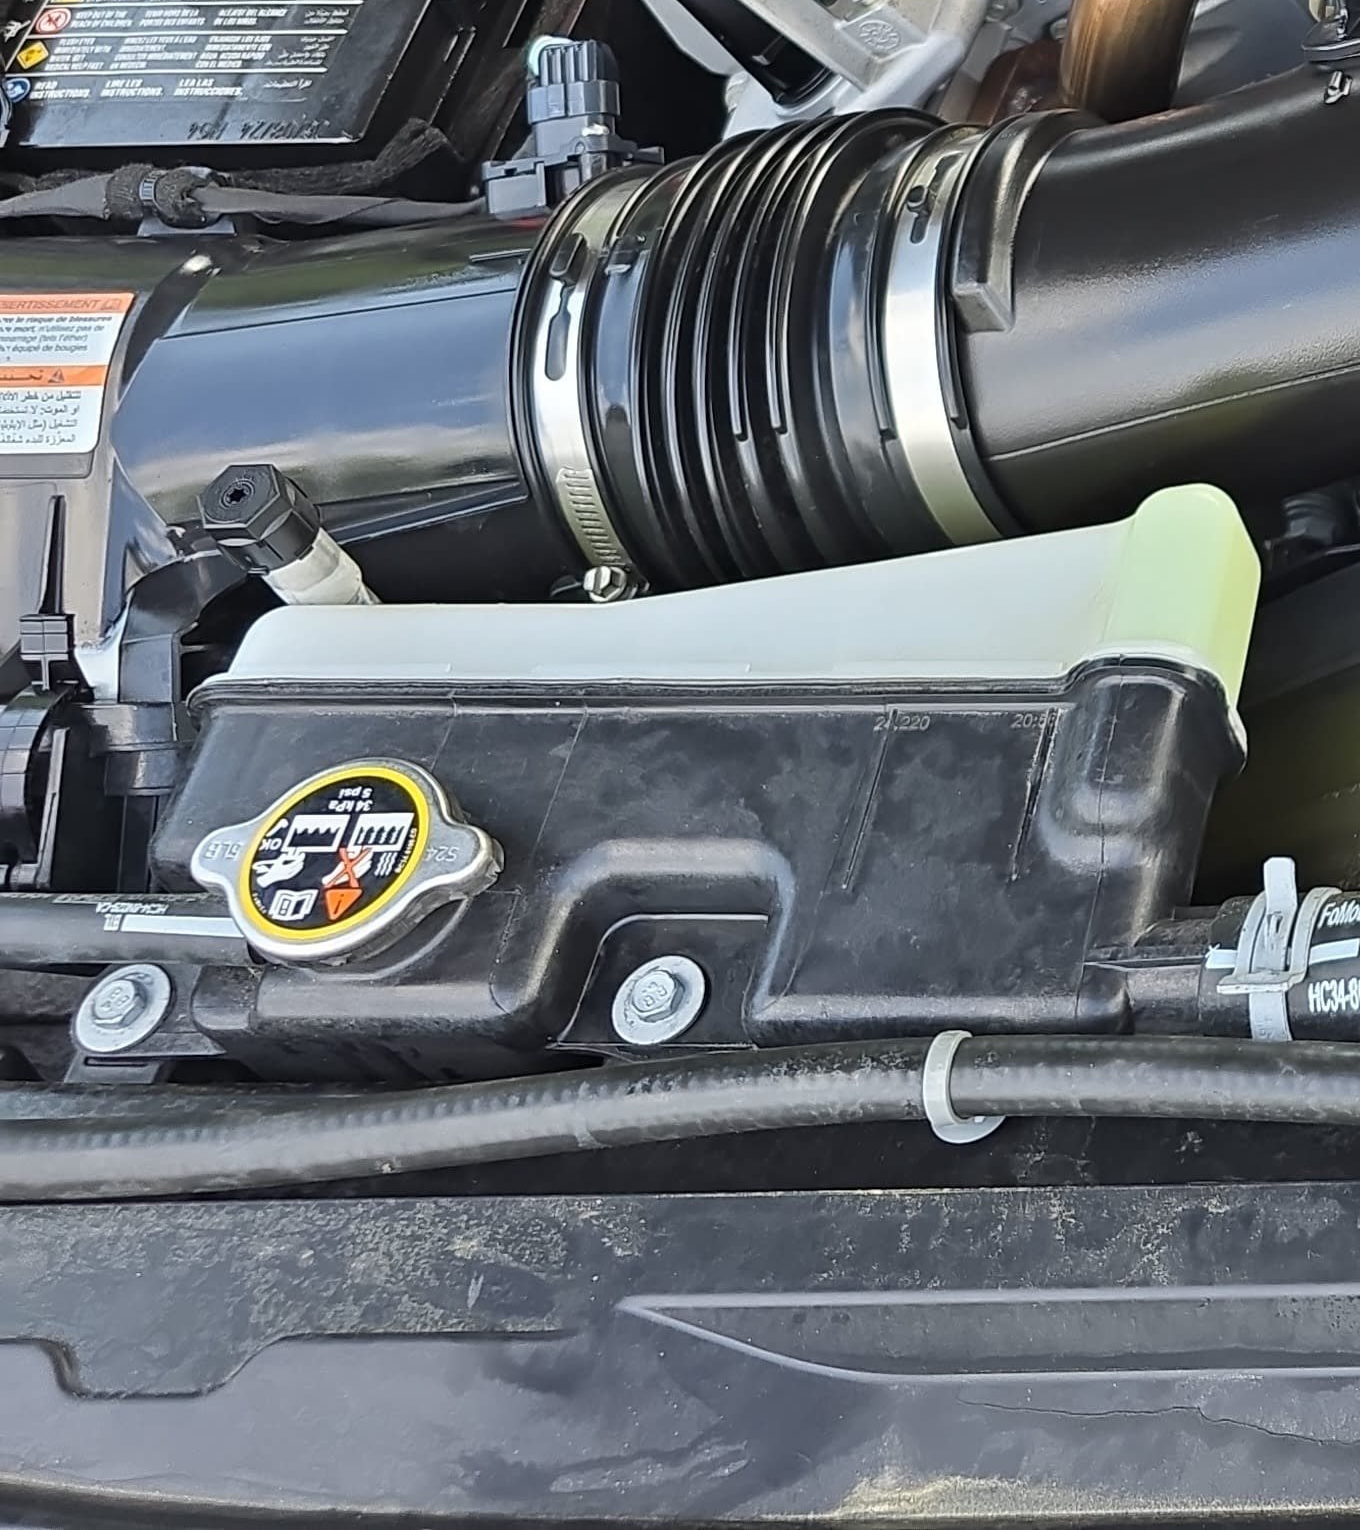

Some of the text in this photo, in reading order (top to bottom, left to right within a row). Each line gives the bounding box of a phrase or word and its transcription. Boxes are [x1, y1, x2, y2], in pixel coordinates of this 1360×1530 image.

[338, 786, 373, 799] 5 psi
[328, 799, 373, 812] 34 kPa
[261, 837, 283, 851] OK
